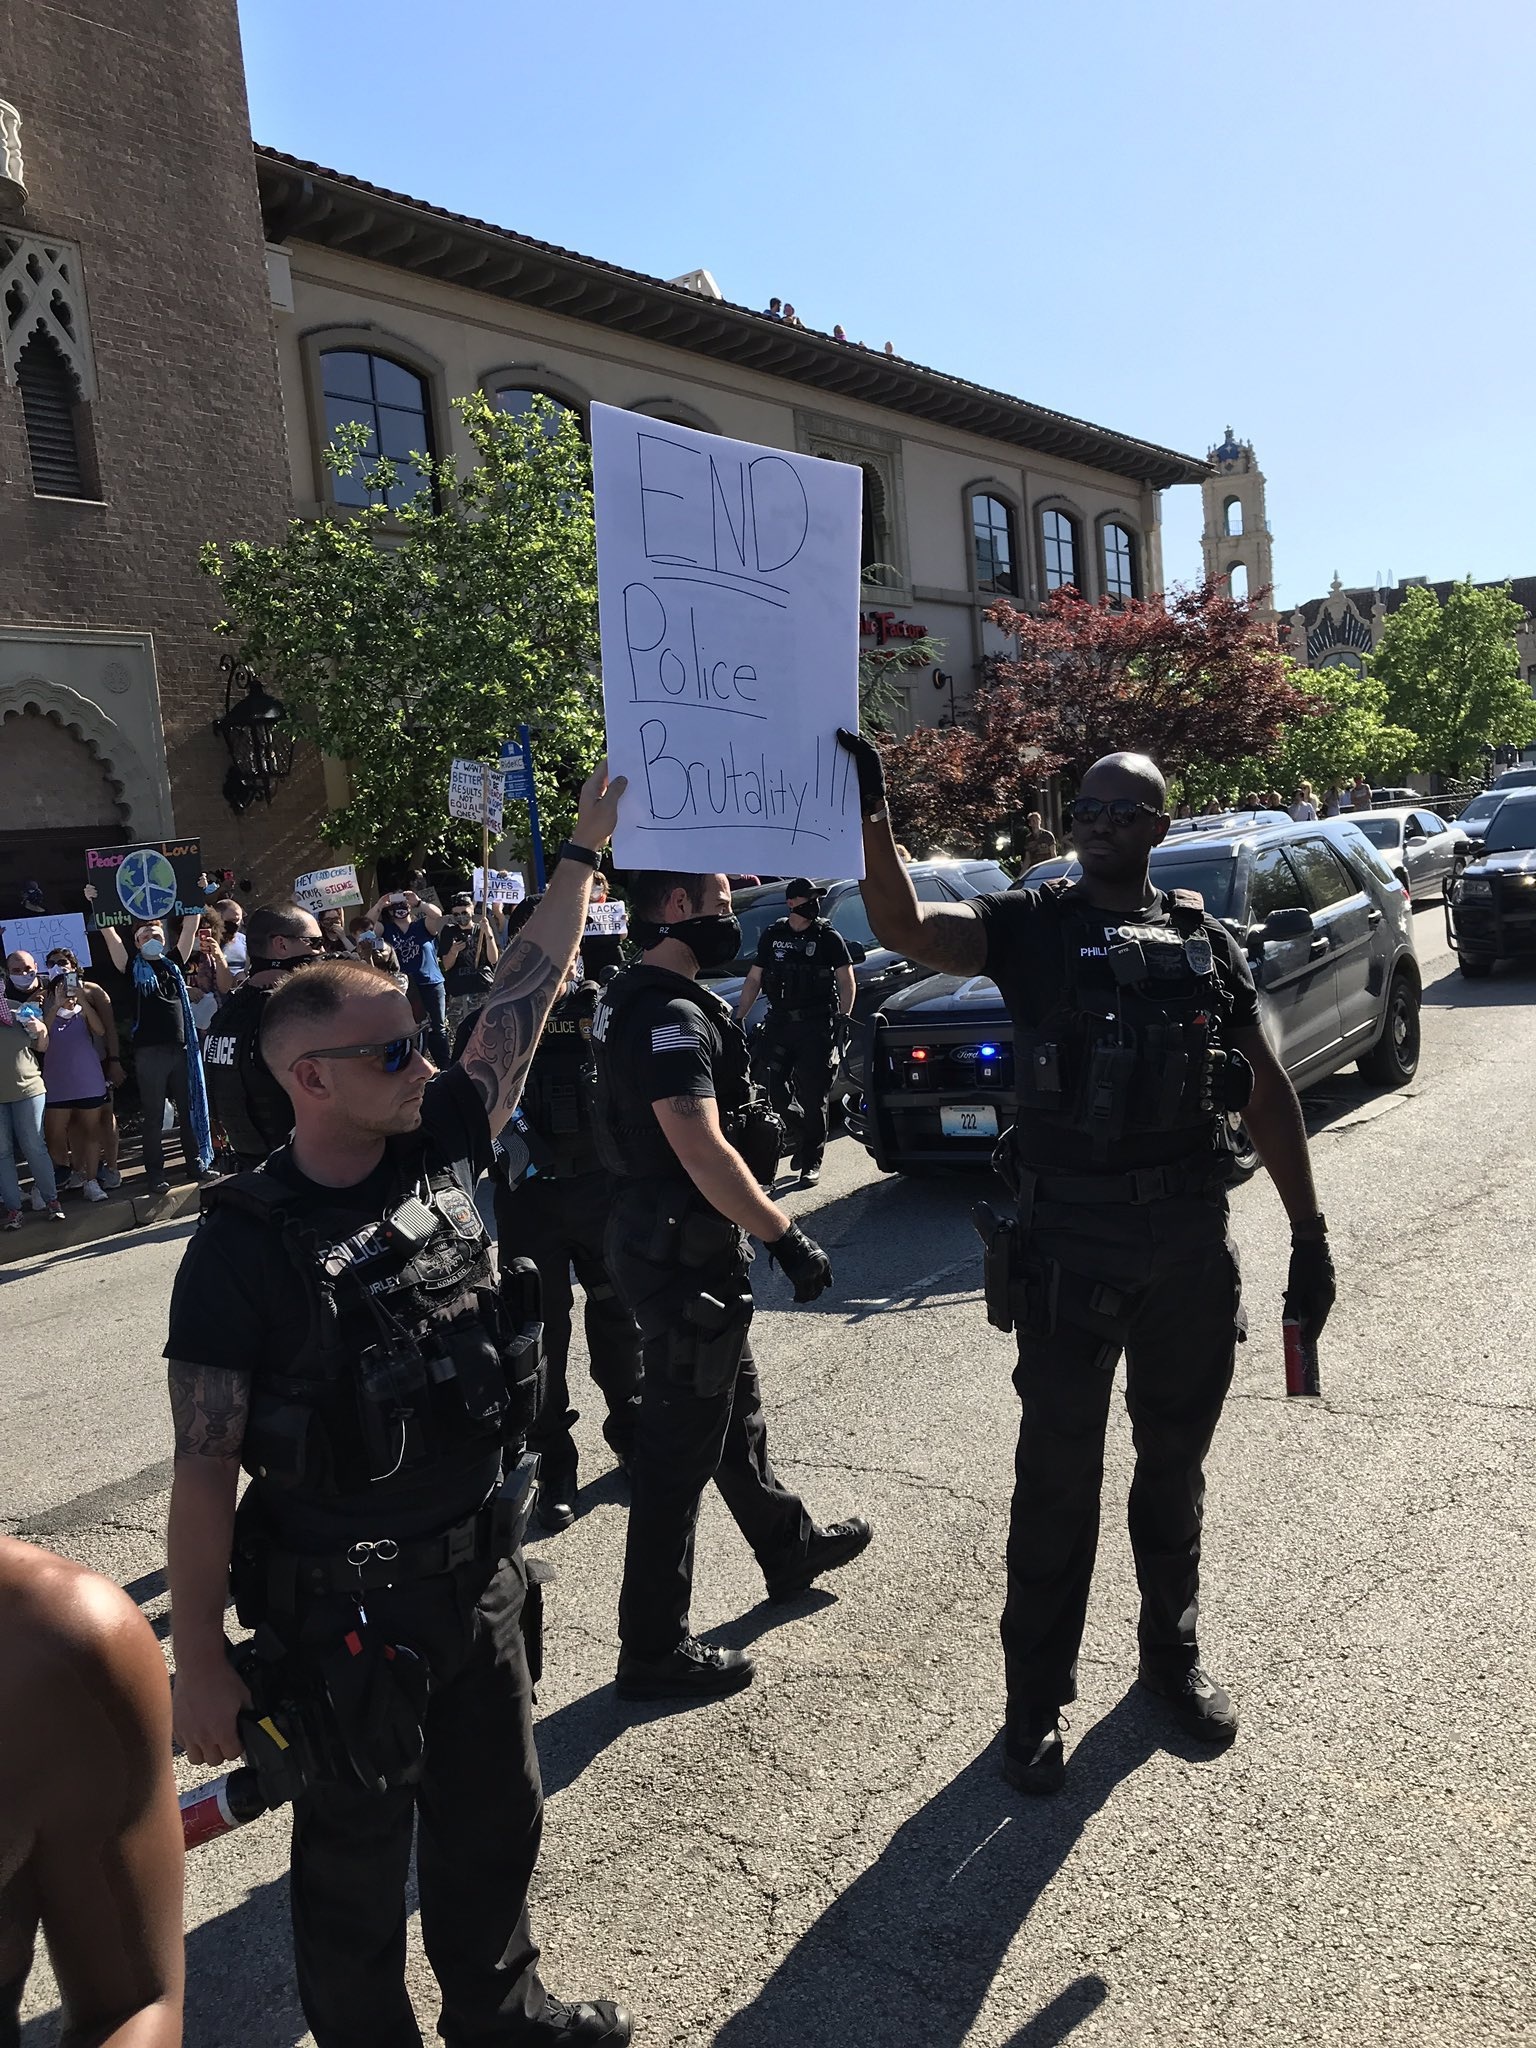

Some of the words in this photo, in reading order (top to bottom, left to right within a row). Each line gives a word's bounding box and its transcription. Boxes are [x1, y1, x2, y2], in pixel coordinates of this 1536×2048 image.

[637, 433, 808, 571] END
[623, 583, 757, 701] Police
[454, 761, 460, 769] I
[463, 762, 483, 773] WANT
[501, 758, 523, 769] RideKC
[452, 771, 483, 786] BETTER
[451, 783, 482, 798] RESULTS
[450, 799, 481, 814] EQUAL
[459, 794, 474, 804] NOT
[456, 810, 477, 820] ONES
[162, 843, 199, 858] Love
[88, 850, 125, 869] Peace
[296, 873, 313, 887] HEY
[296, 887, 322, 901] YOUR
[309, 899, 324, 911] IS
[96, 911, 133, 928] Unity
[592, 914, 615, 923] IVES
[14, 919, 69, 937] BLACK
[658, 926, 670, 934] RZ
[1103, 925, 1184, 945] POLICE
[957, 1050, 979, 1059] Ford
[960, 1113, 977, 1130] 222
